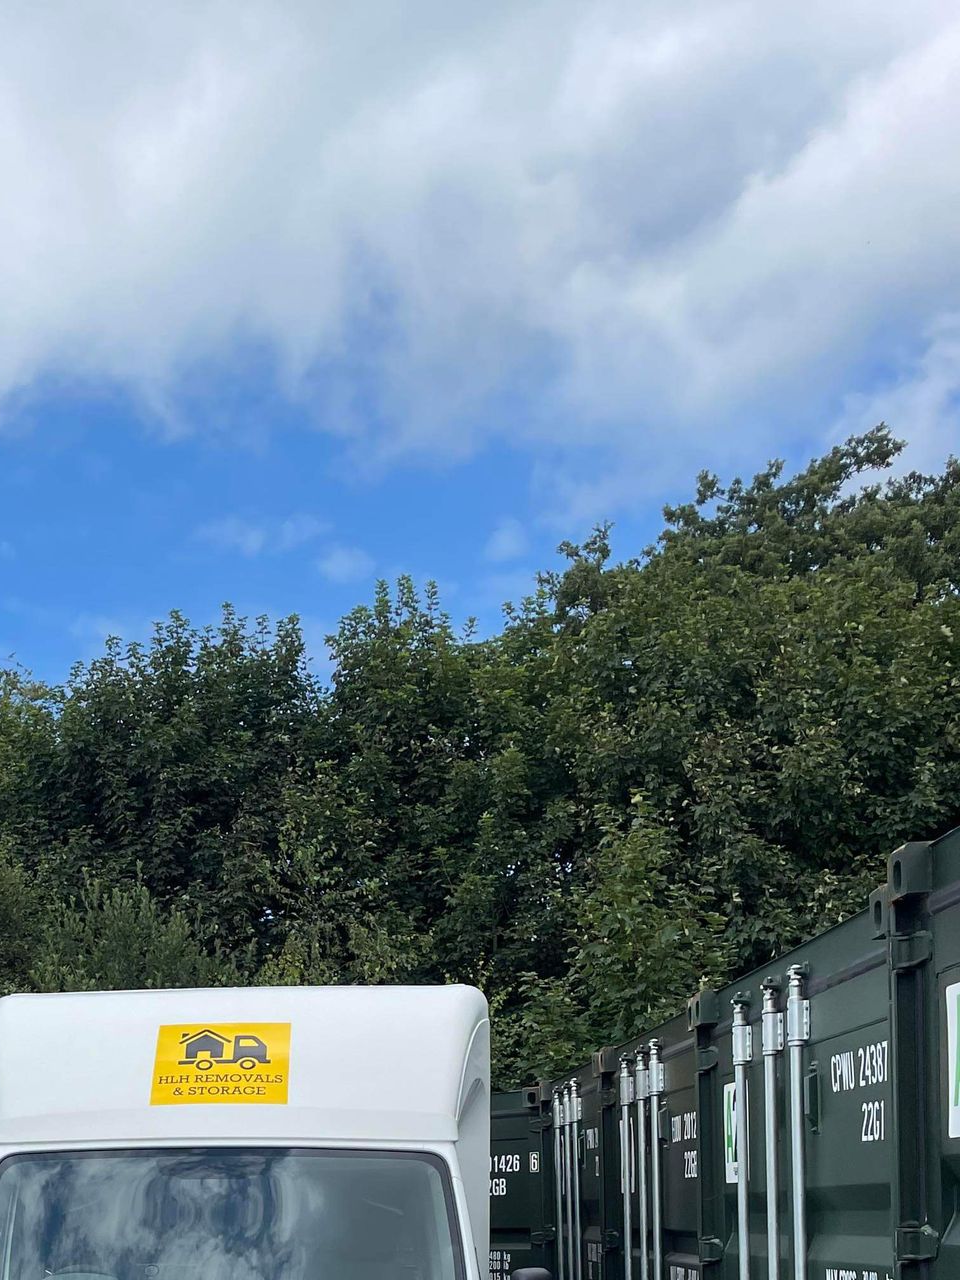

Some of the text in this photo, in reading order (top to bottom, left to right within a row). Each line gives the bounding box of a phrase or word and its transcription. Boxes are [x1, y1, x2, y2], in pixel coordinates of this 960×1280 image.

[830, 1041, 888, 1093] CPWU 24387
[158, 1074, 283, 1084] HLH REMOVALS
[173, 1086, 266, 1096] & STORAGE
[861, 1100, 885, 1142] 22G1
[531, 1153, 538, 1171] 6
[489, 1251, 501, 1261] 480
[489, 1261, 501, 1270] 200
